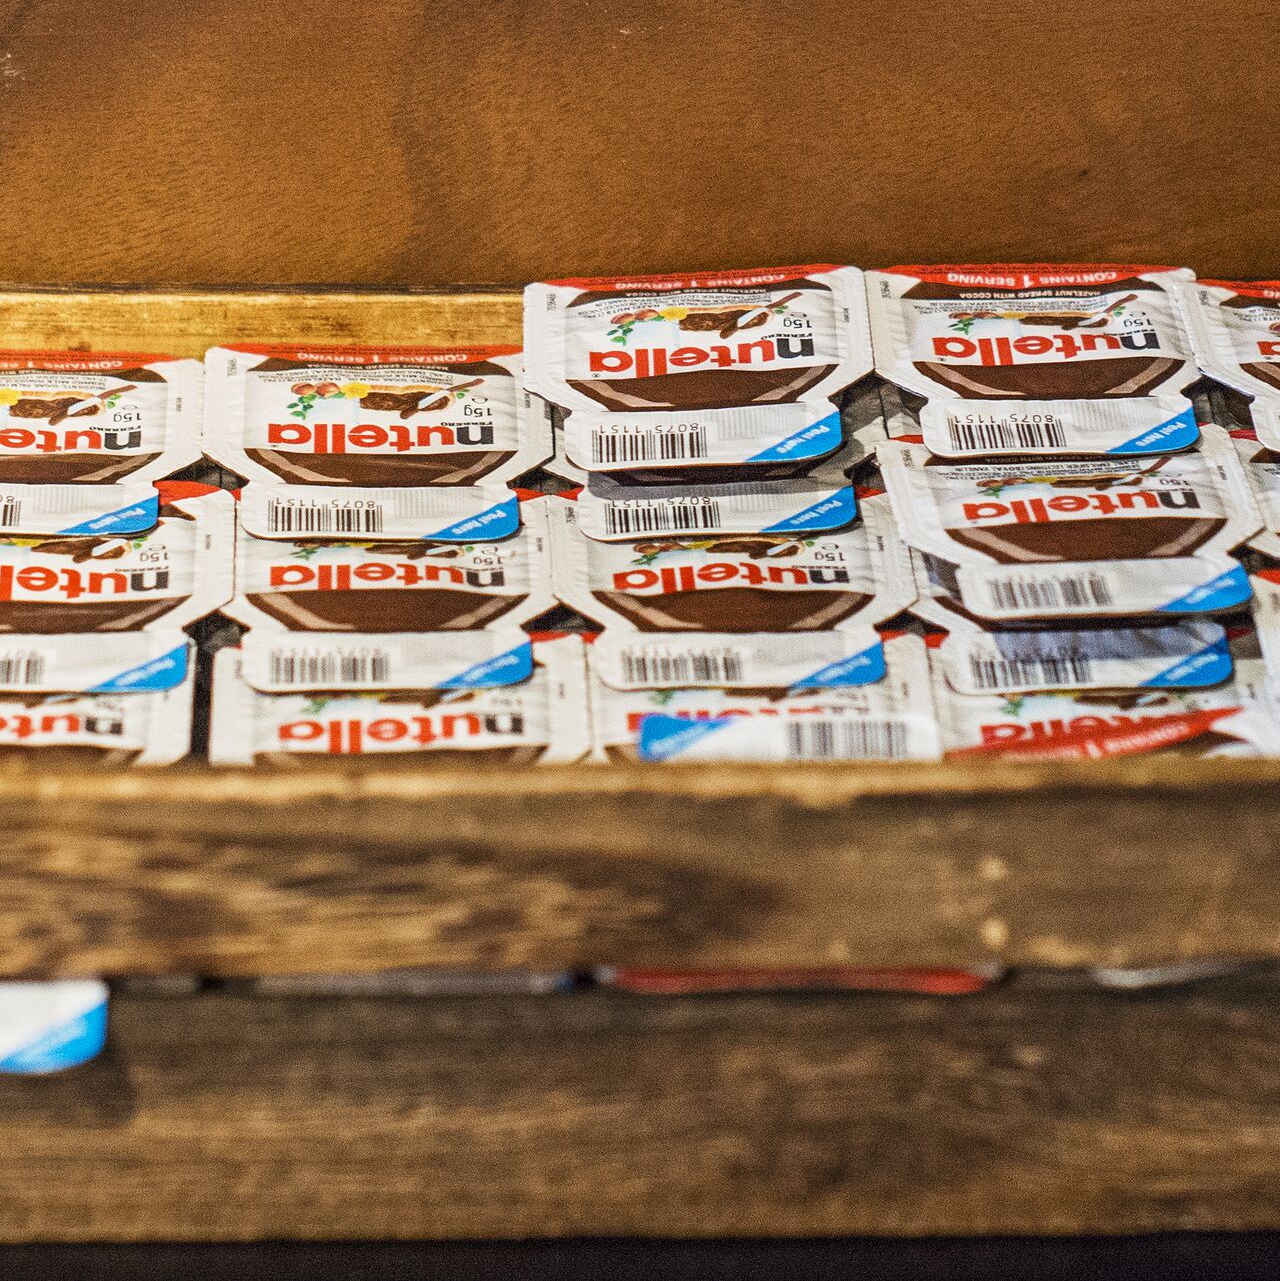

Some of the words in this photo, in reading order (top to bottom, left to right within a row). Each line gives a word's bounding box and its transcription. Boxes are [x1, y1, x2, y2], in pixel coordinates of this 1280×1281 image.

[947, 273, 1015, 286] SERVING
[1024, 274, 1033, 288] 1
[1039, 272, 1116, 285] CONTAINS
[783, 317, 812, 329] 15g
[932, 332, 1160, 366] nutella
[297, 352, 364, 362] SERVING
[388, 353, 467, 363] CONTAINS
[589, 338, 814, 378] nutella
[464, 405, 493, 417] 15g
[113, 412, 142, 423] 15g
[954, 414, 995, 424] 1151
[1010, 413, 1053, 423] 8075
[598, 424, 642, 434] 1151
[654, 423, 699, 433] 8075
[268, 424, 493, 453] nutella
[275, 497, 317, 508] 1151
[331, 499, 375, 509] 8075
[611, 498, 653, 509] 1151
[666, 496, 710, 506] 8075
[962, 491, 1201, 523] nutella
[814, 551, 845, 562] 15g
[269, 563, 505, 590] nutella
[613, 562, 849, 593] nutella
[278, 713, 525, 754] nutella
